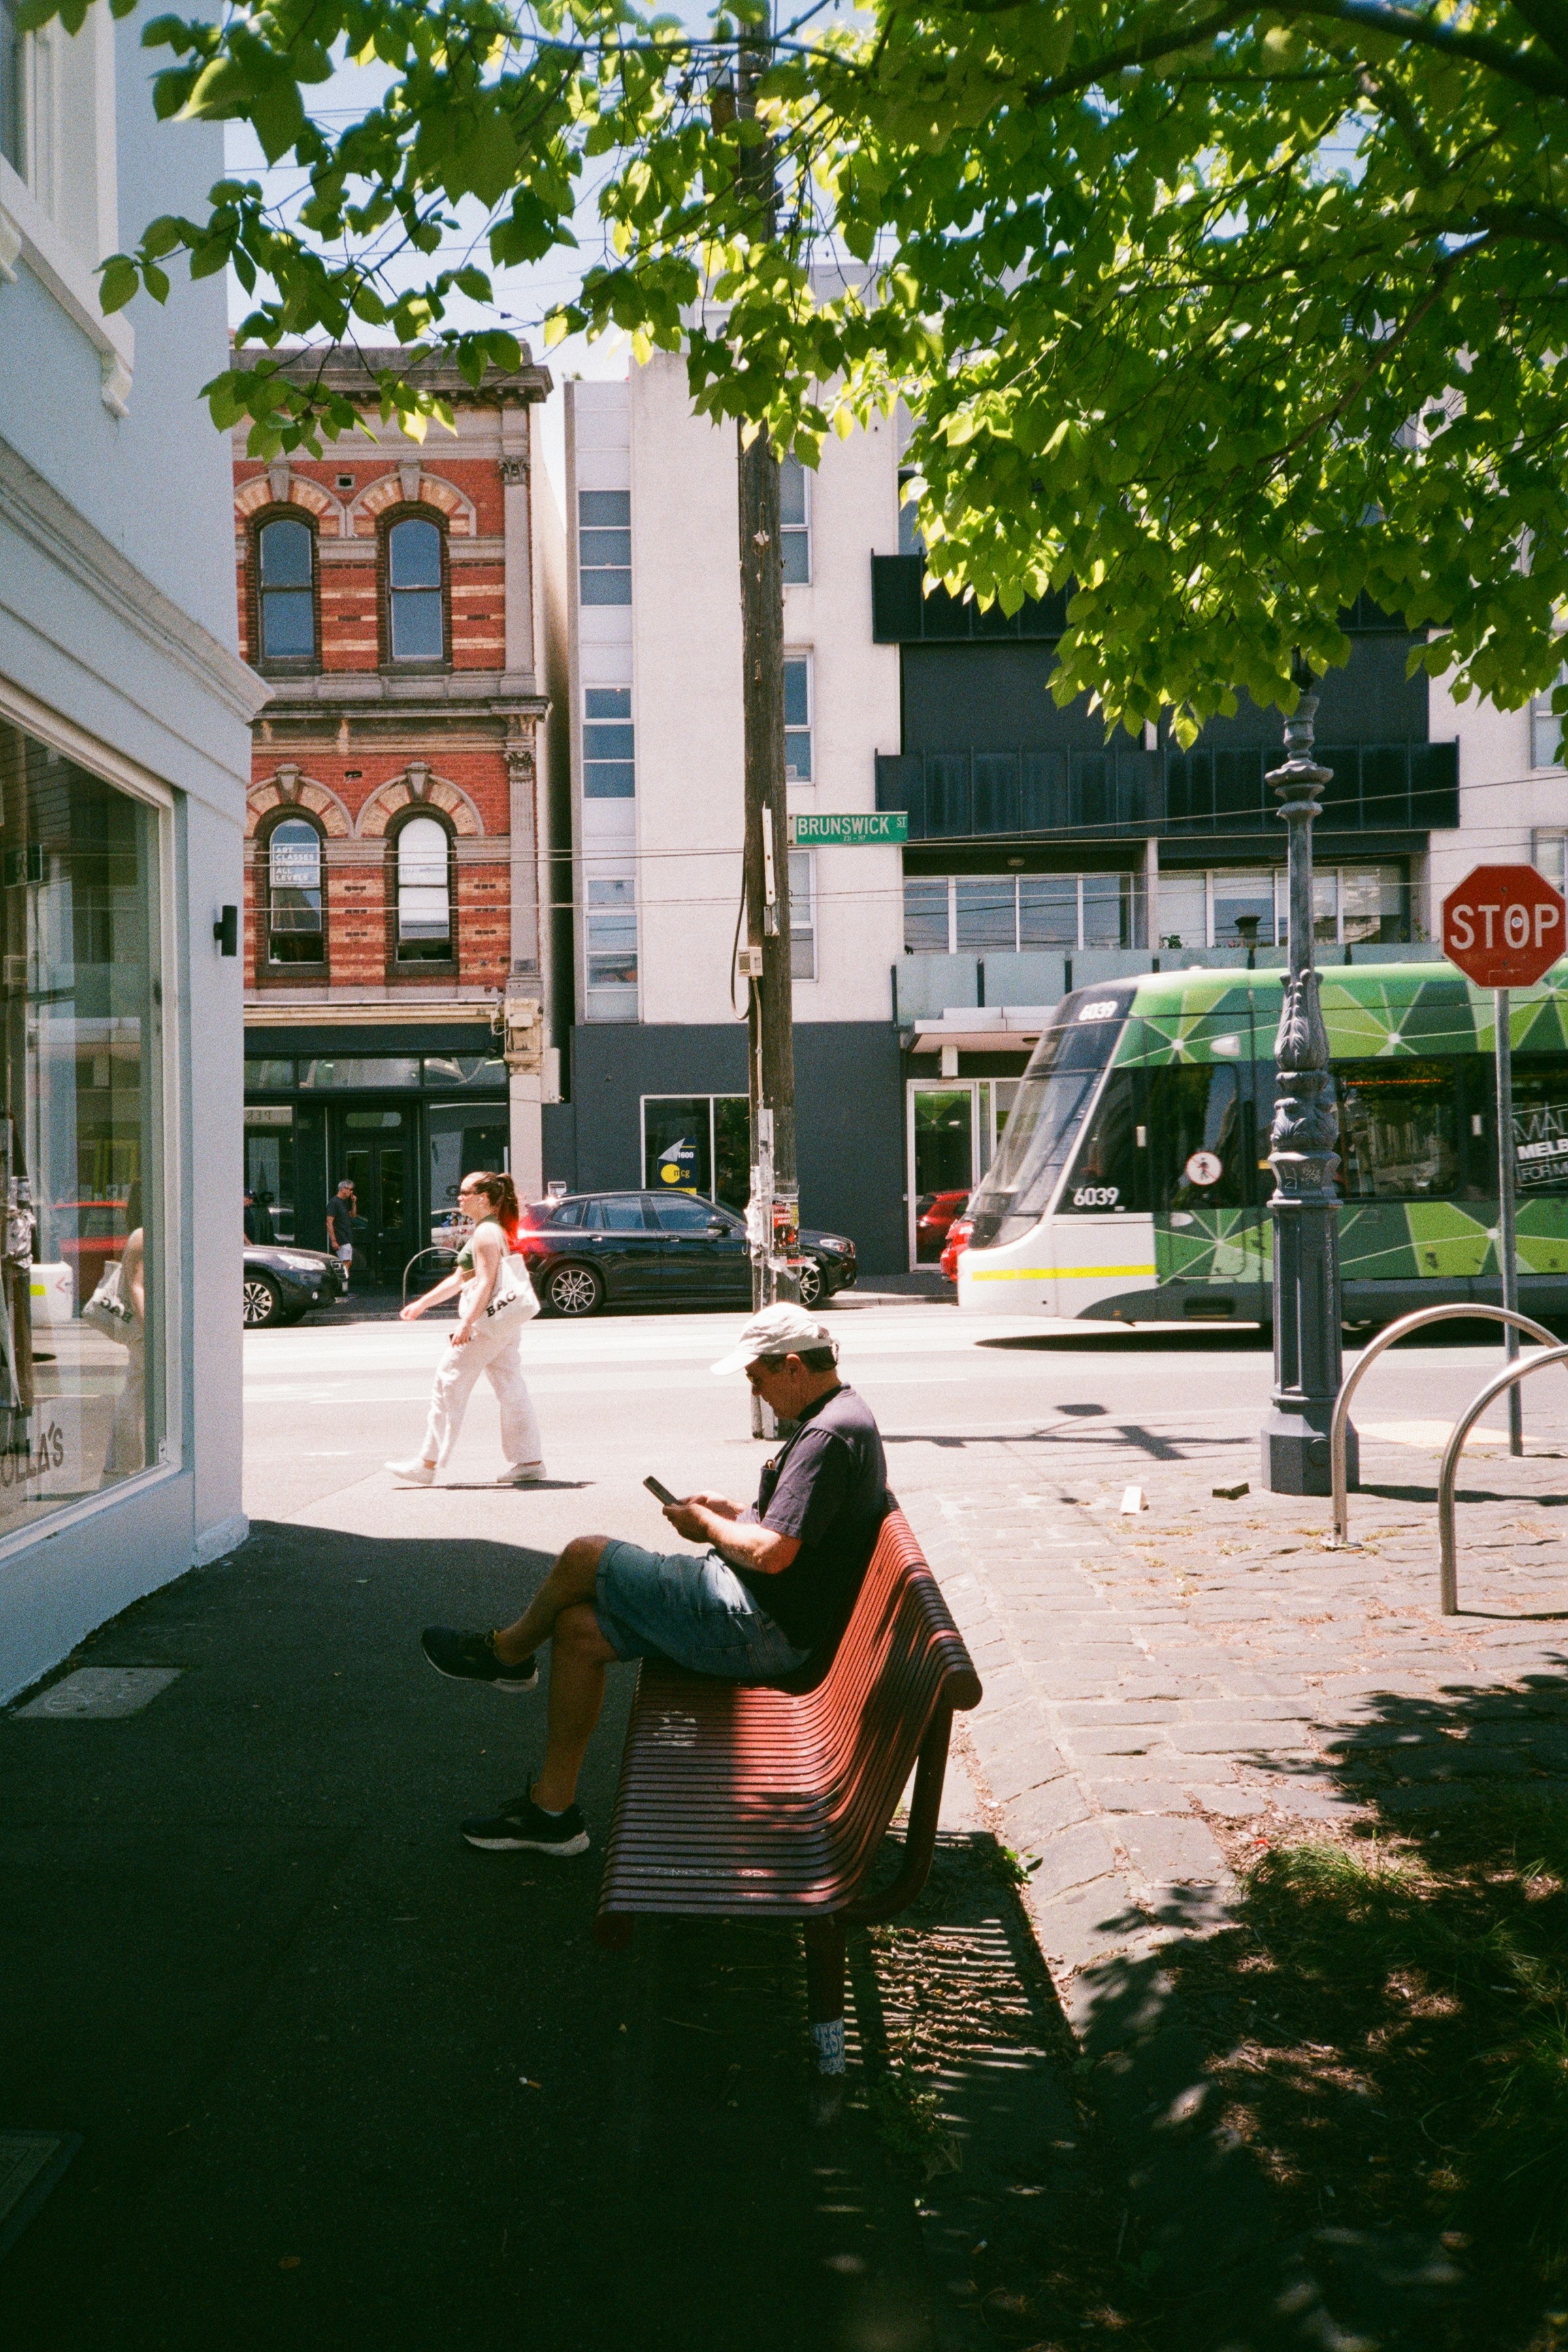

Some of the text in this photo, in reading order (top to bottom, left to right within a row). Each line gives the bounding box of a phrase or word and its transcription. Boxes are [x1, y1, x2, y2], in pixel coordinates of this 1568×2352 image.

[798, 817, 906, 836] BRUNSWICK ST
[1450, 904, 1560, 949] STOP
[1079, 1001, 1118, 1021] 6039
[674, 1169, 691, 1179] mcg
[1073, 1186, 1119, 1205] 6039
